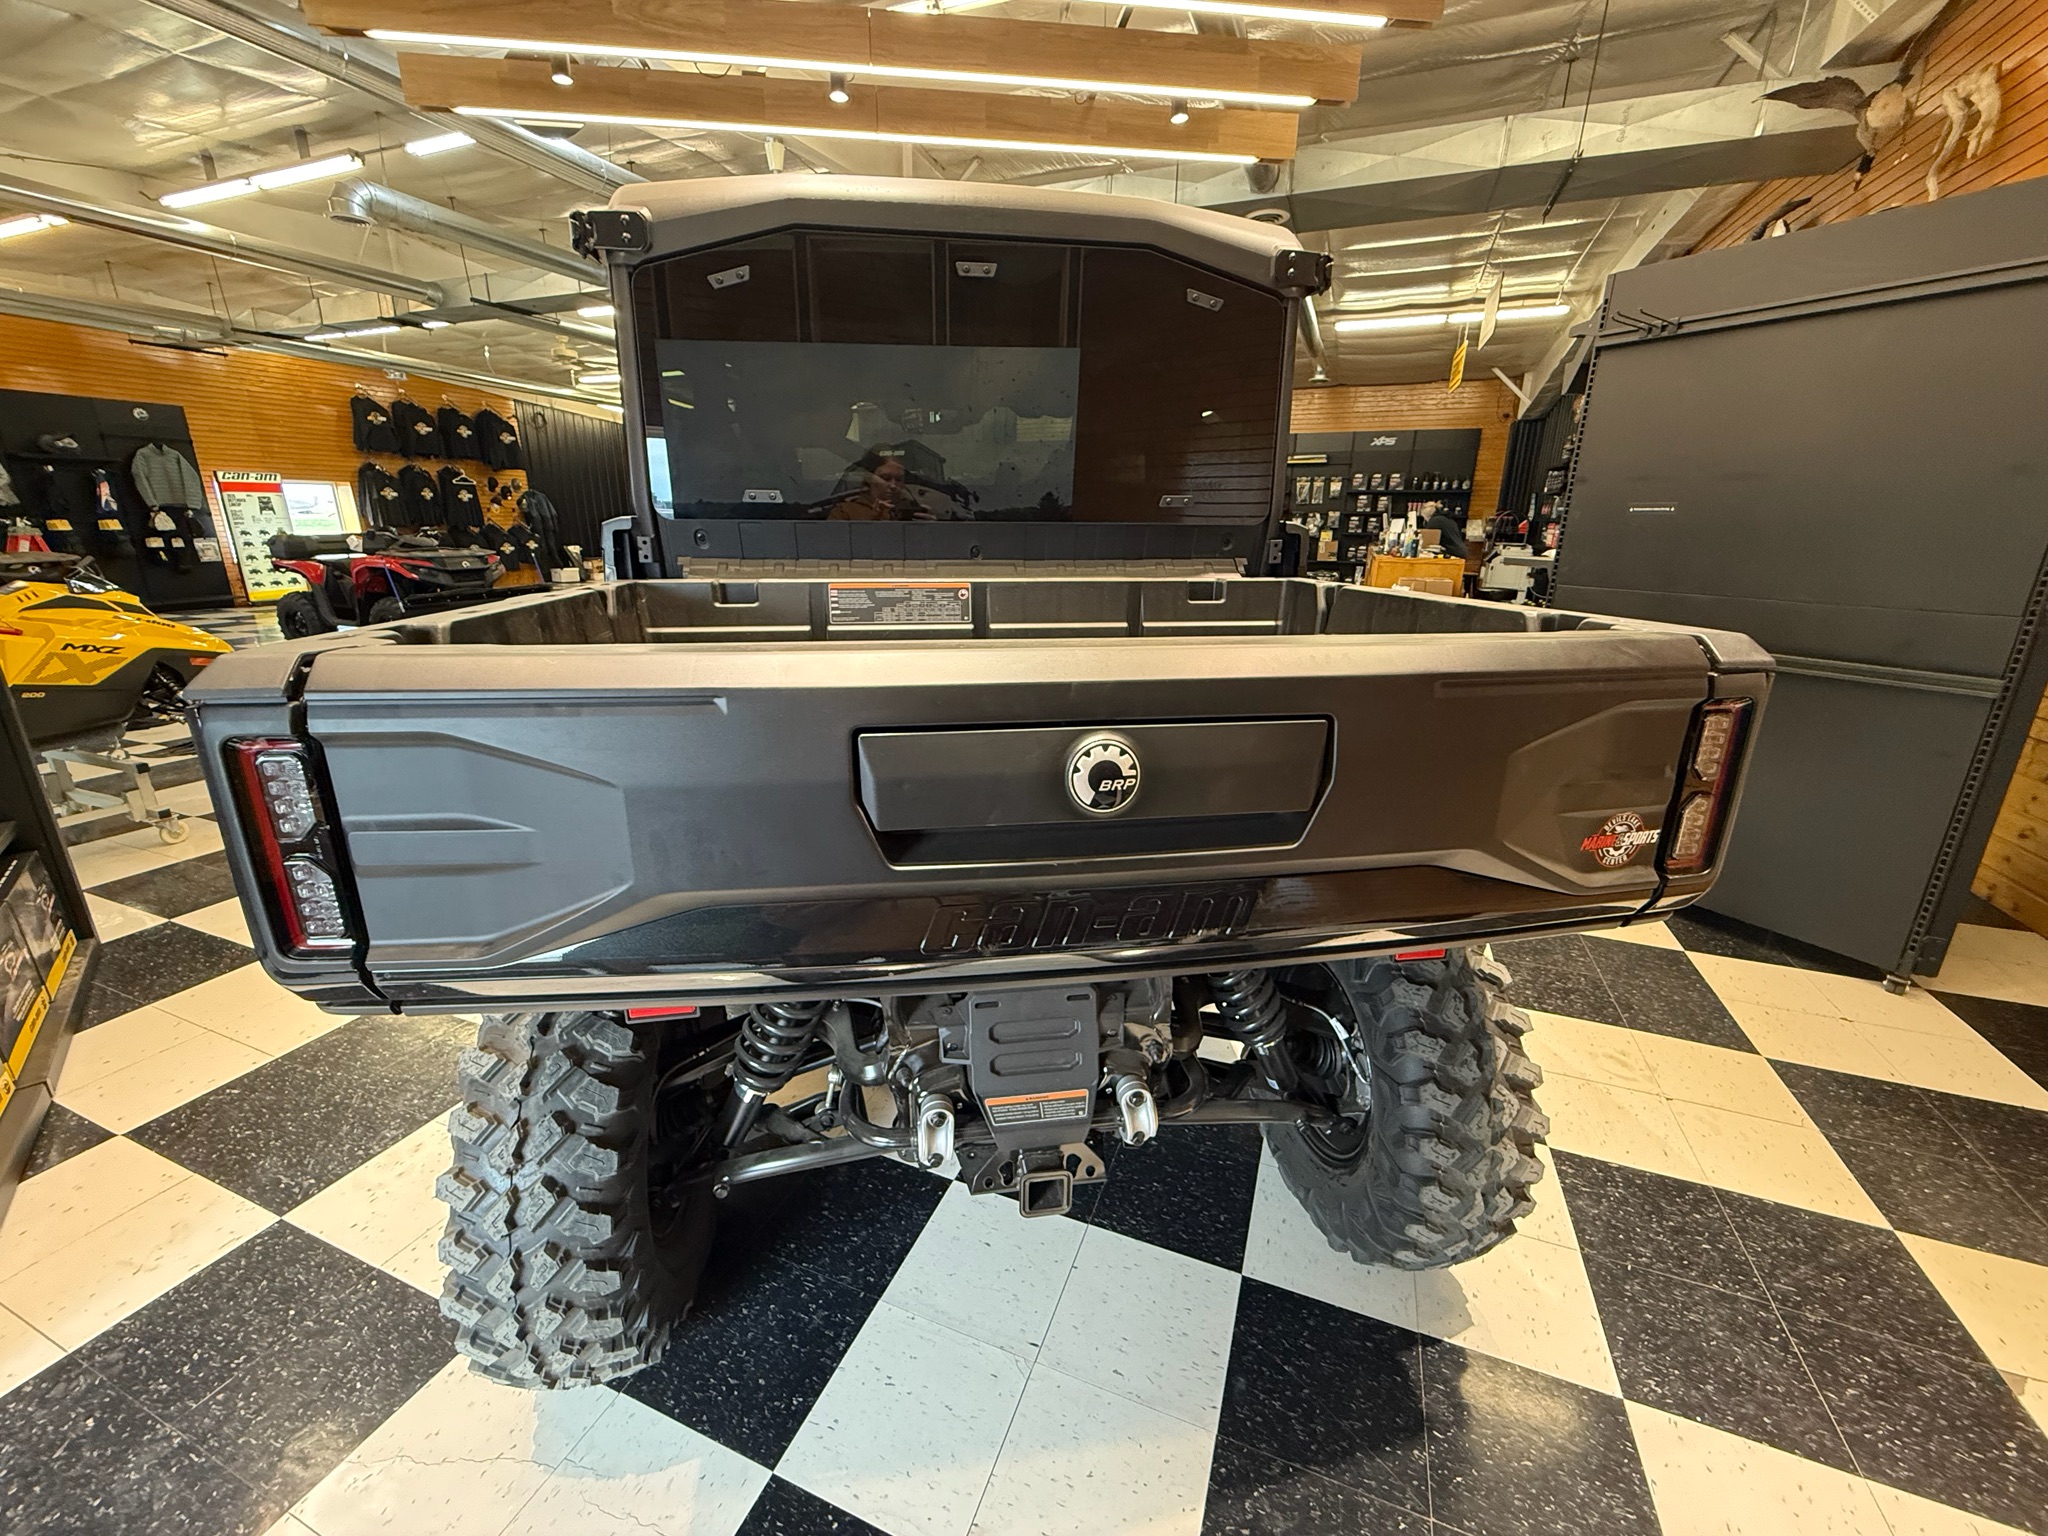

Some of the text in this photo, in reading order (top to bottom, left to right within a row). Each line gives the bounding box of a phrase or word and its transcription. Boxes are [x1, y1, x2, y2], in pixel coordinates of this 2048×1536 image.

[1370, 436, 1398, 446] XPS
[222, 472, 277, 481] can-am
[60, 643, 126, 655] MXZ
[1099, 778, 1137, 792] BRP
[1621, 829, 1661, 846] SPORTS
[1602, 854, 1628, 866] CENTER
[919, 891, 1256, 955] can-am
